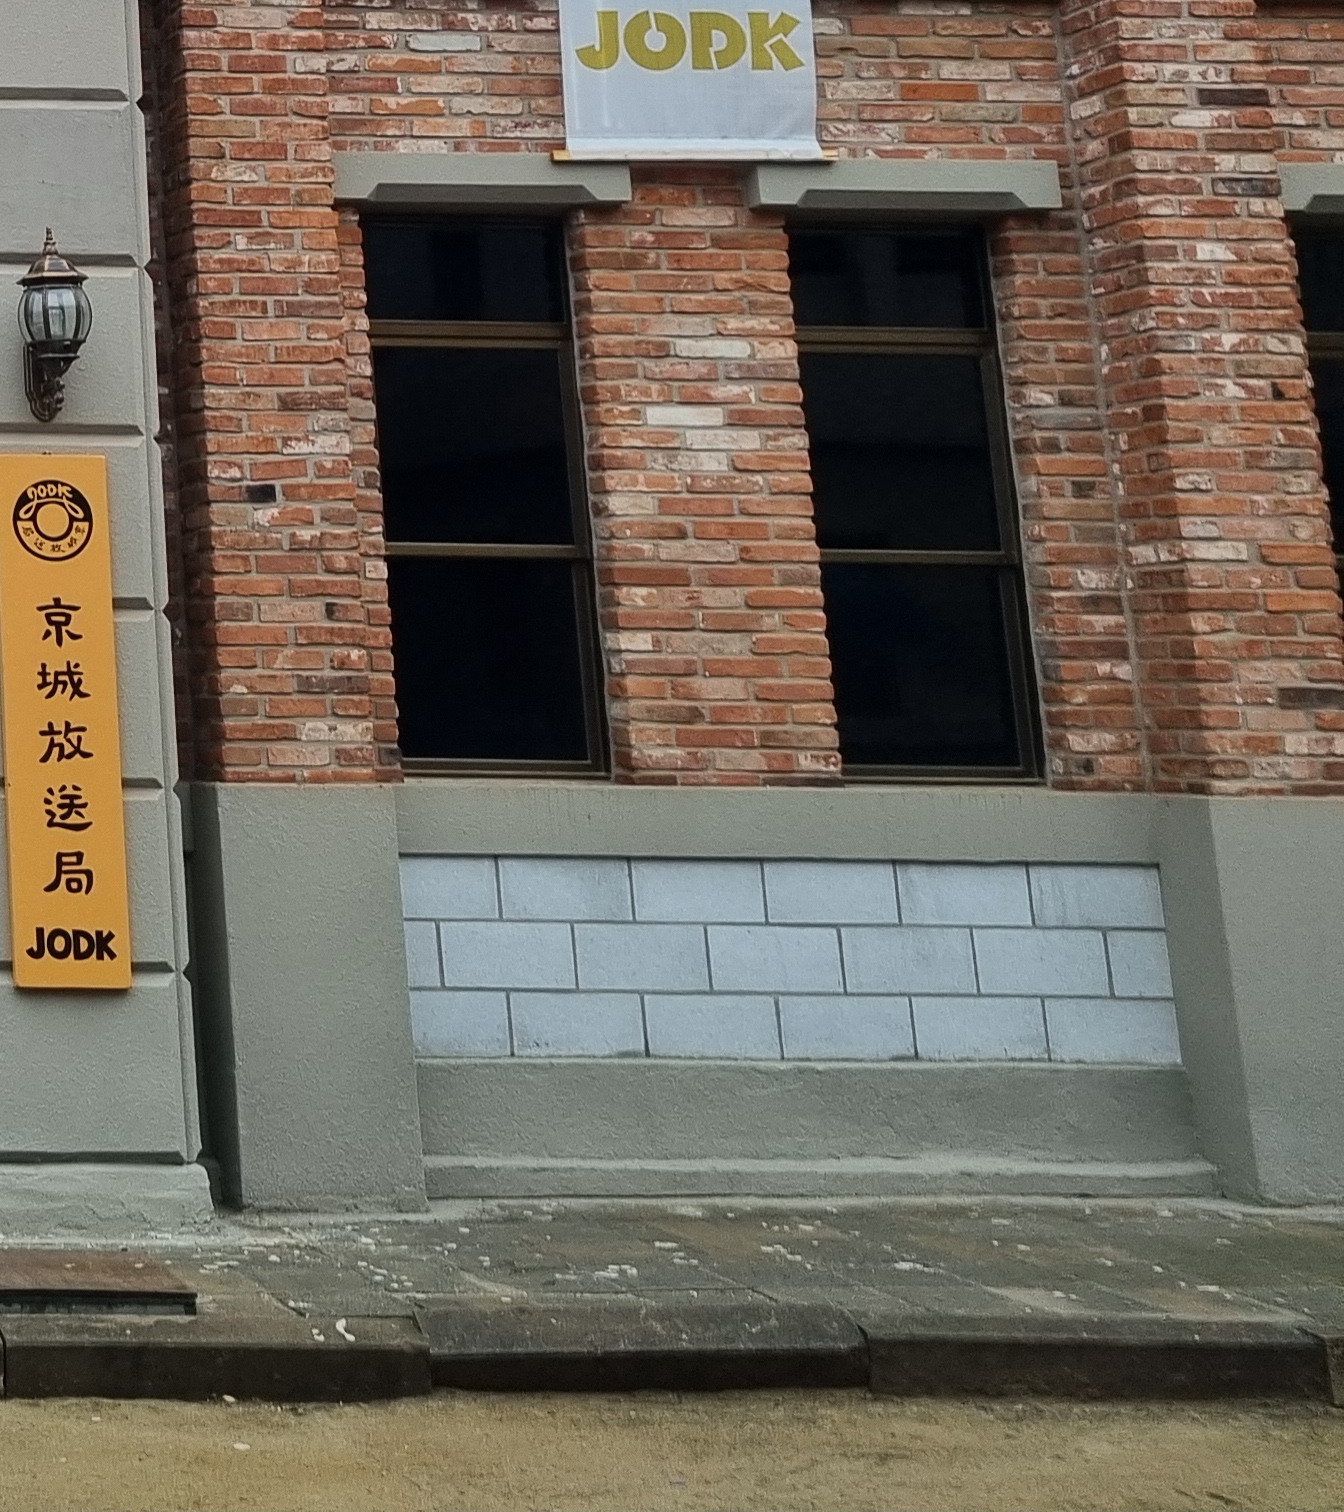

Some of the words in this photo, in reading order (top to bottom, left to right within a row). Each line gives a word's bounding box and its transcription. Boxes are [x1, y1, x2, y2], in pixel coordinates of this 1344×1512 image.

[574, 9, 807, 72] JODK
[35, 596, 94, 895] 京城放送局
[26, 927, 117, 961] JODK
